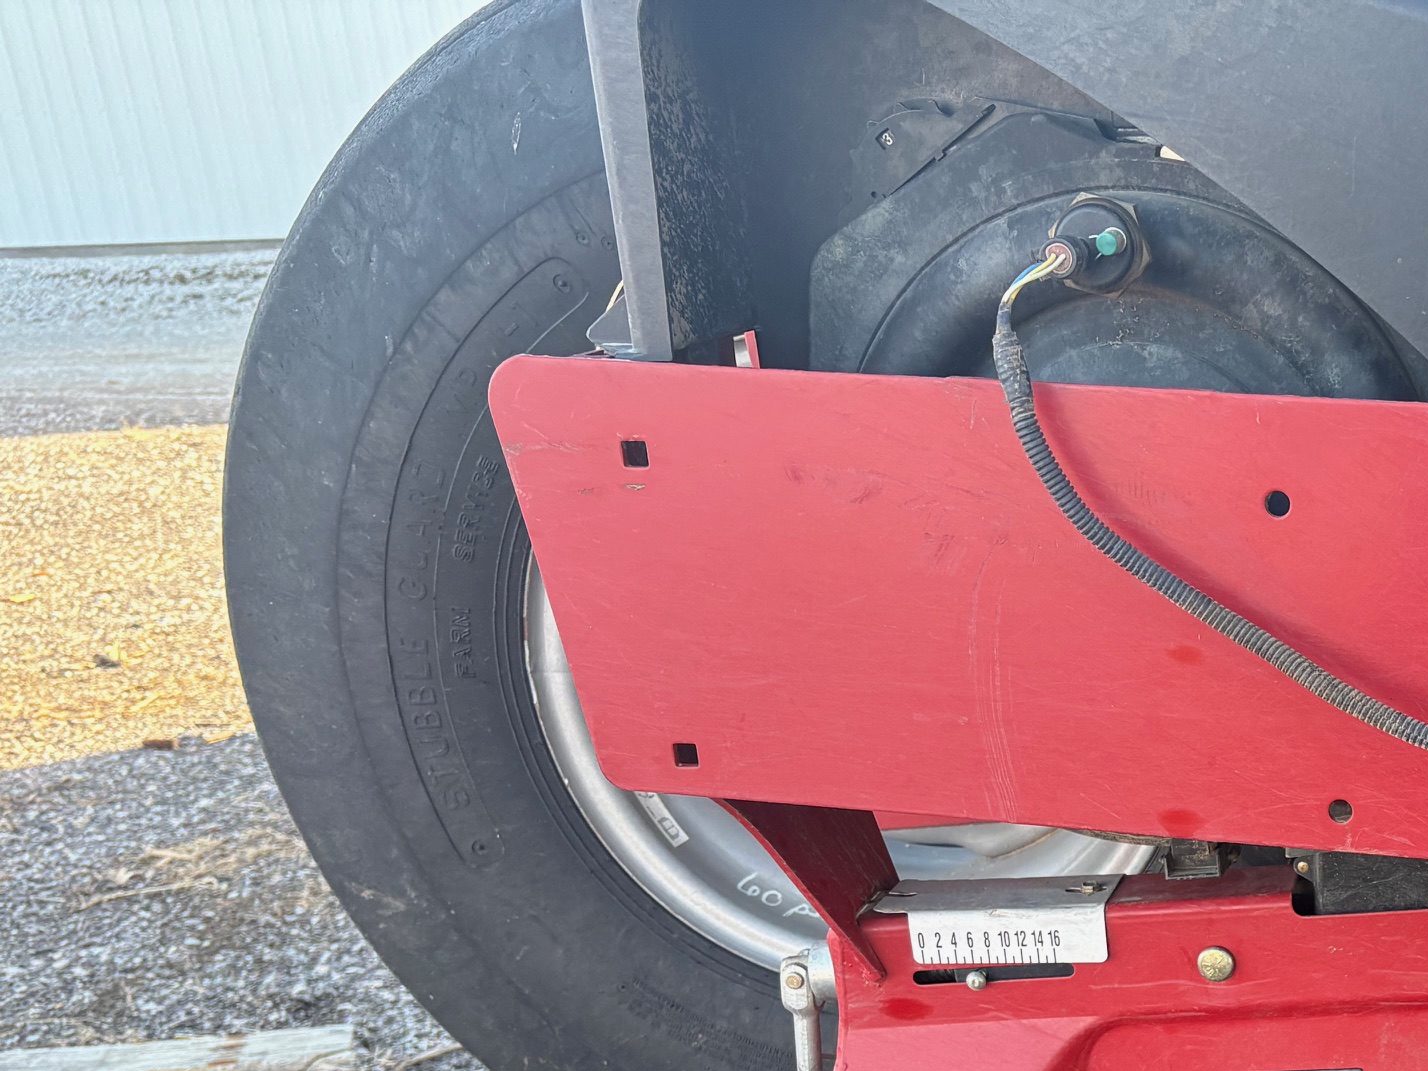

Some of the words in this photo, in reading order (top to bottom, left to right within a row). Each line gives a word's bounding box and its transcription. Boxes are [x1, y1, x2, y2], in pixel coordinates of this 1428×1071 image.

[397, 459, 446, 602] GUARD
[452, 455, 499, 564] SERVICE
[450, 607, 477, 679] FARM
[398, 637, 471, 812] STUBBLE
[917, 932, 926, 949] 0
[934, 932, 943, 949] 2
[950, 931, 958, 949] 4
[966, 931, 974, 948] 6
[983, 931, 991, 948] 8
[997, 930, 1011, 948] 10
[1014, 930, 1028, 948] 12
[1031, 930, 1044, 947] 14
[1047, 929, 1061, 947] 16
